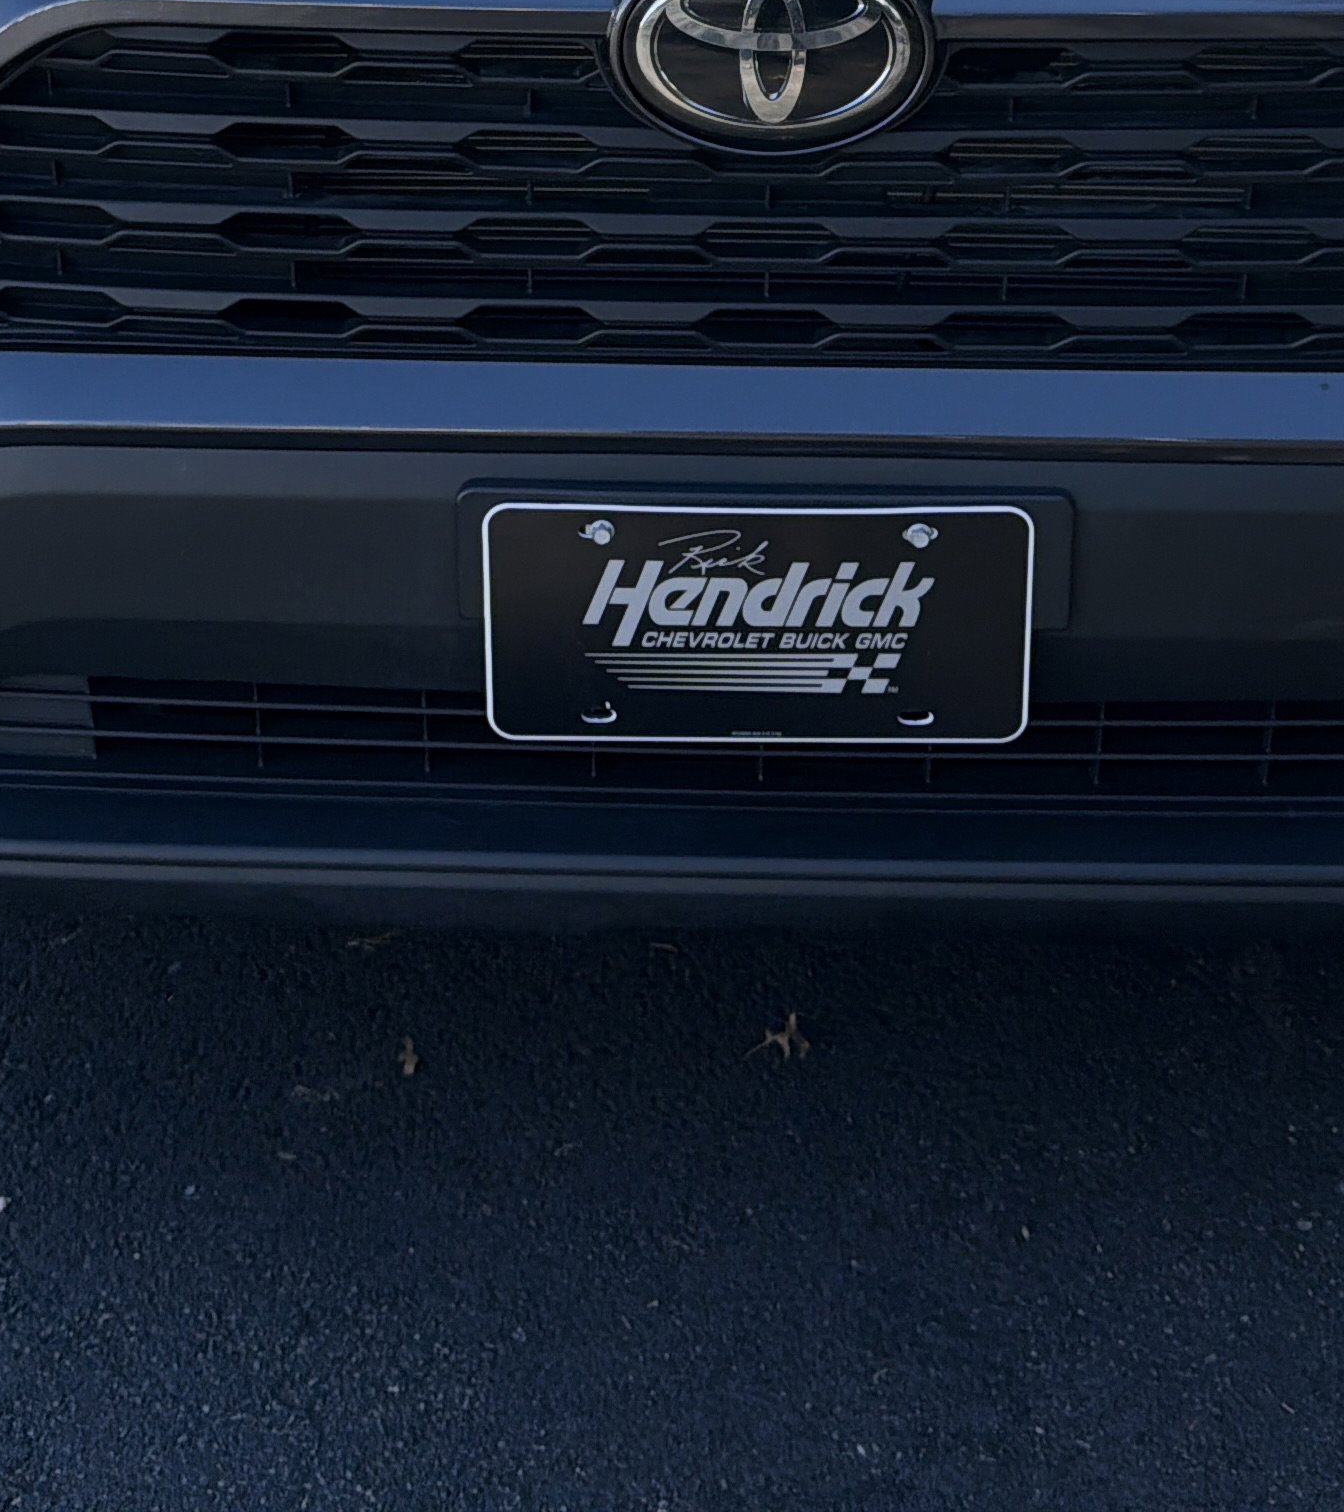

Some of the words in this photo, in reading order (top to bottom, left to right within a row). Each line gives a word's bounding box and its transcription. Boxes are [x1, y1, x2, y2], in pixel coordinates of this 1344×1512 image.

[582, 559, 935, 647] Hendrick
[641, 630, 774, 650] CHEVROLET
[779, 631, 847, 651] BUICK
[854, 632, 909, 651] GMC
